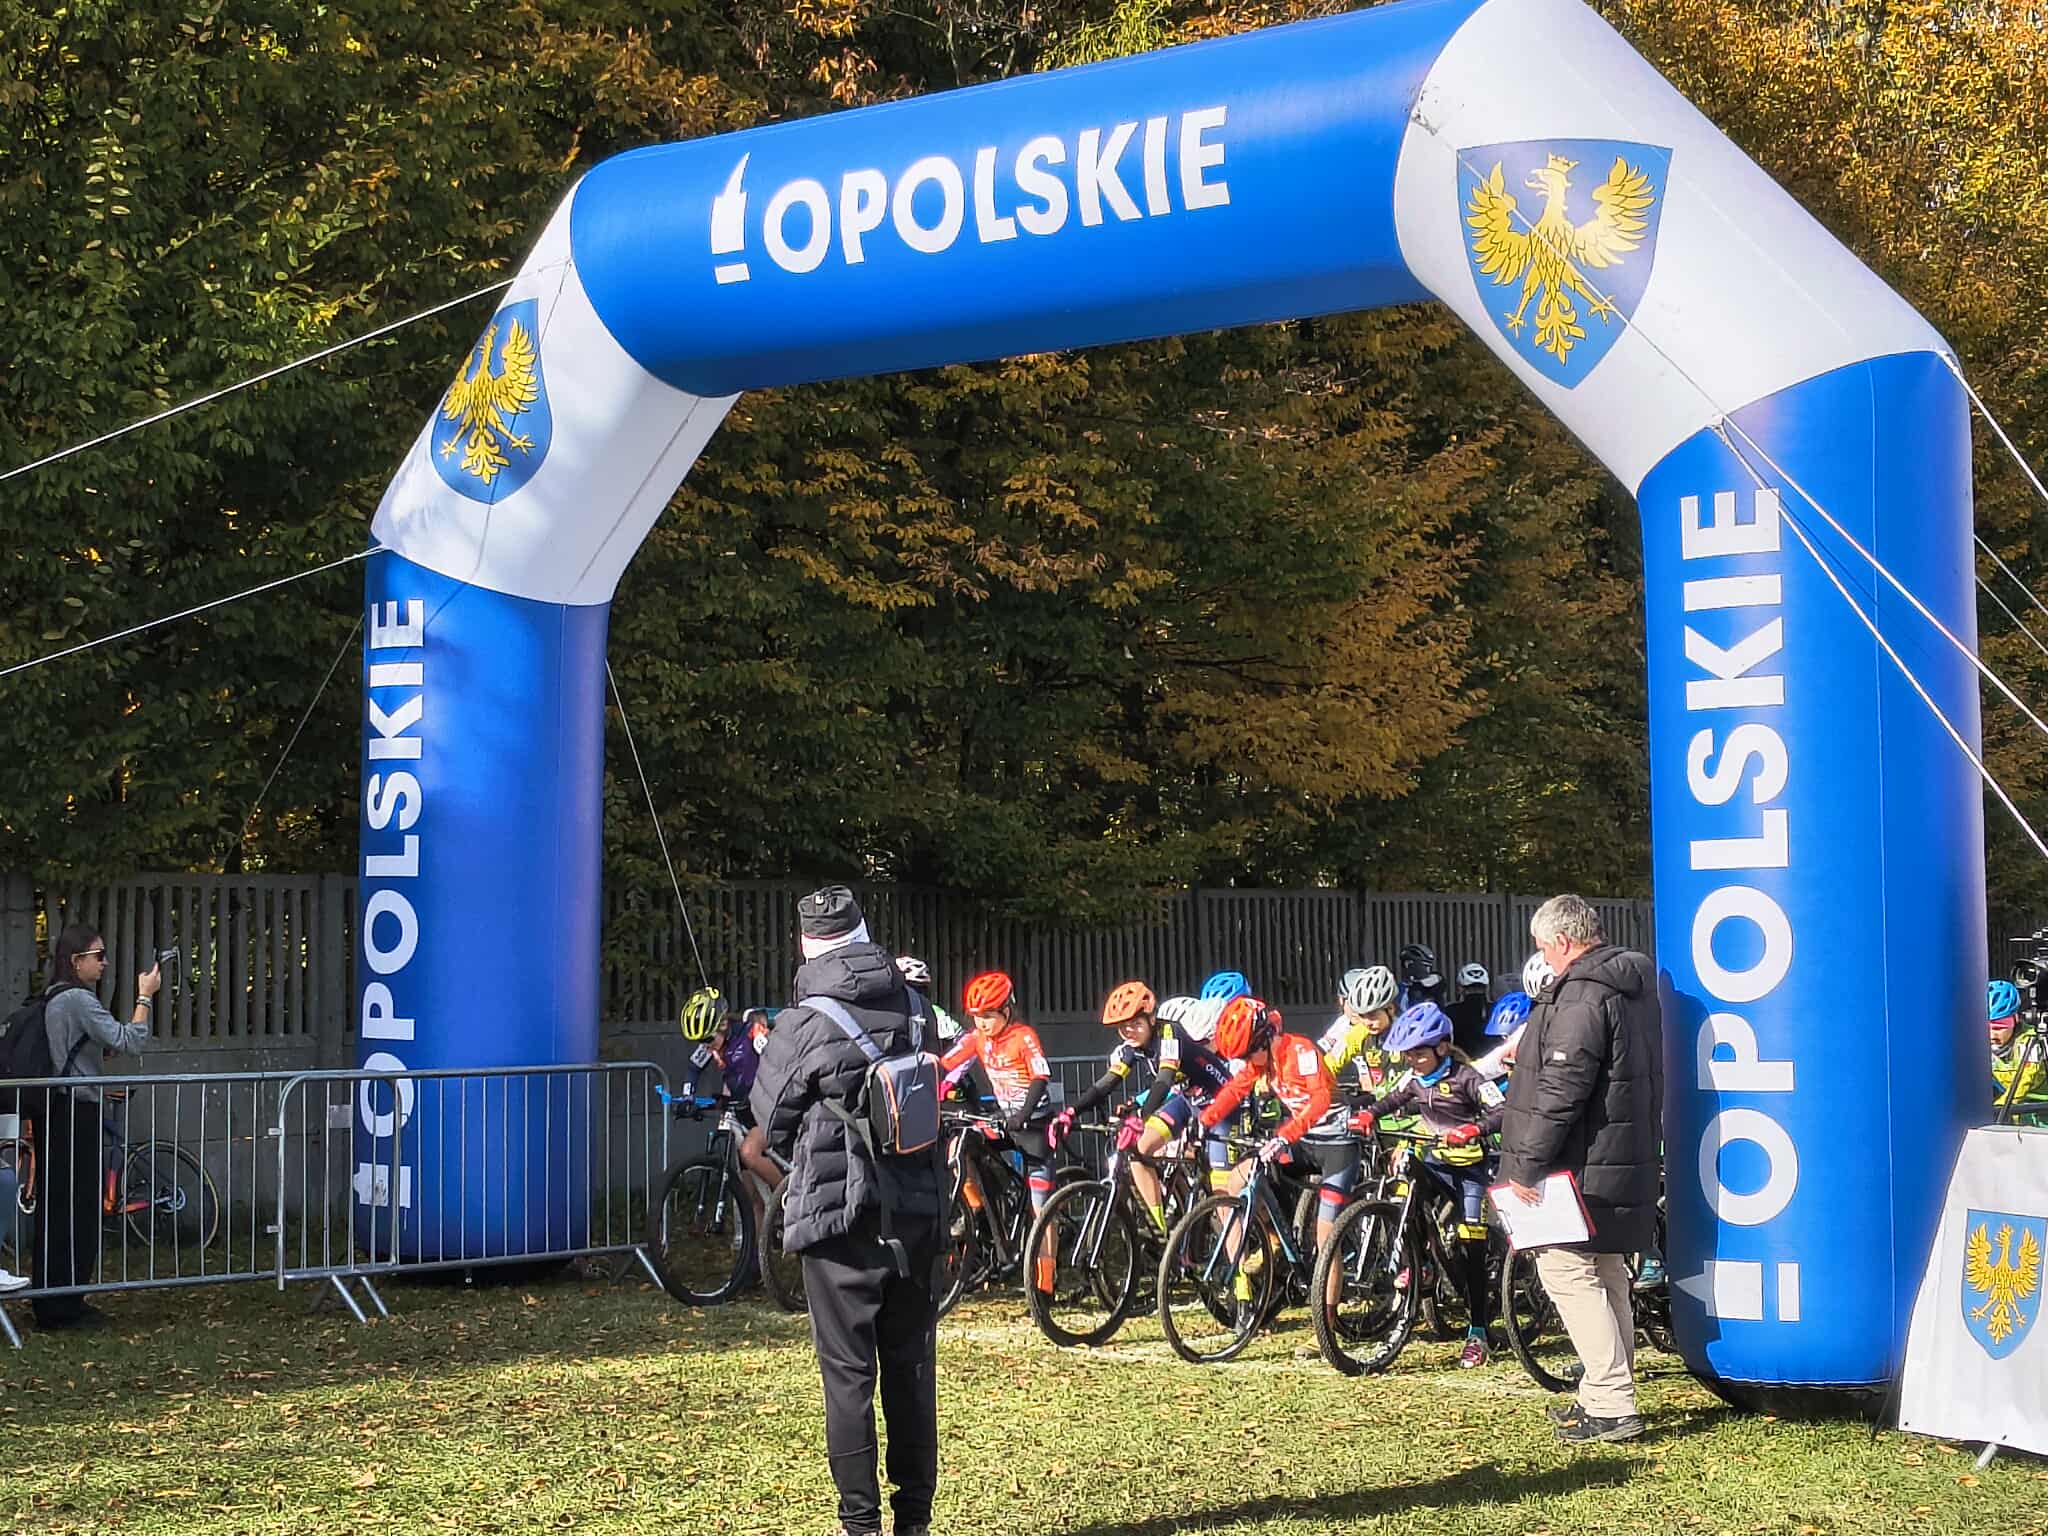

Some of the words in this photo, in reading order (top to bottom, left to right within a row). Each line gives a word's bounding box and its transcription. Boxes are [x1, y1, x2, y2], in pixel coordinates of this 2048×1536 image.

[763, 105, 1231, 274] OPOLSKIE
[358, 598, 425, 1138] OPOLSKIE
[1681, 487, 1799, 1226] OPOLSKIE
